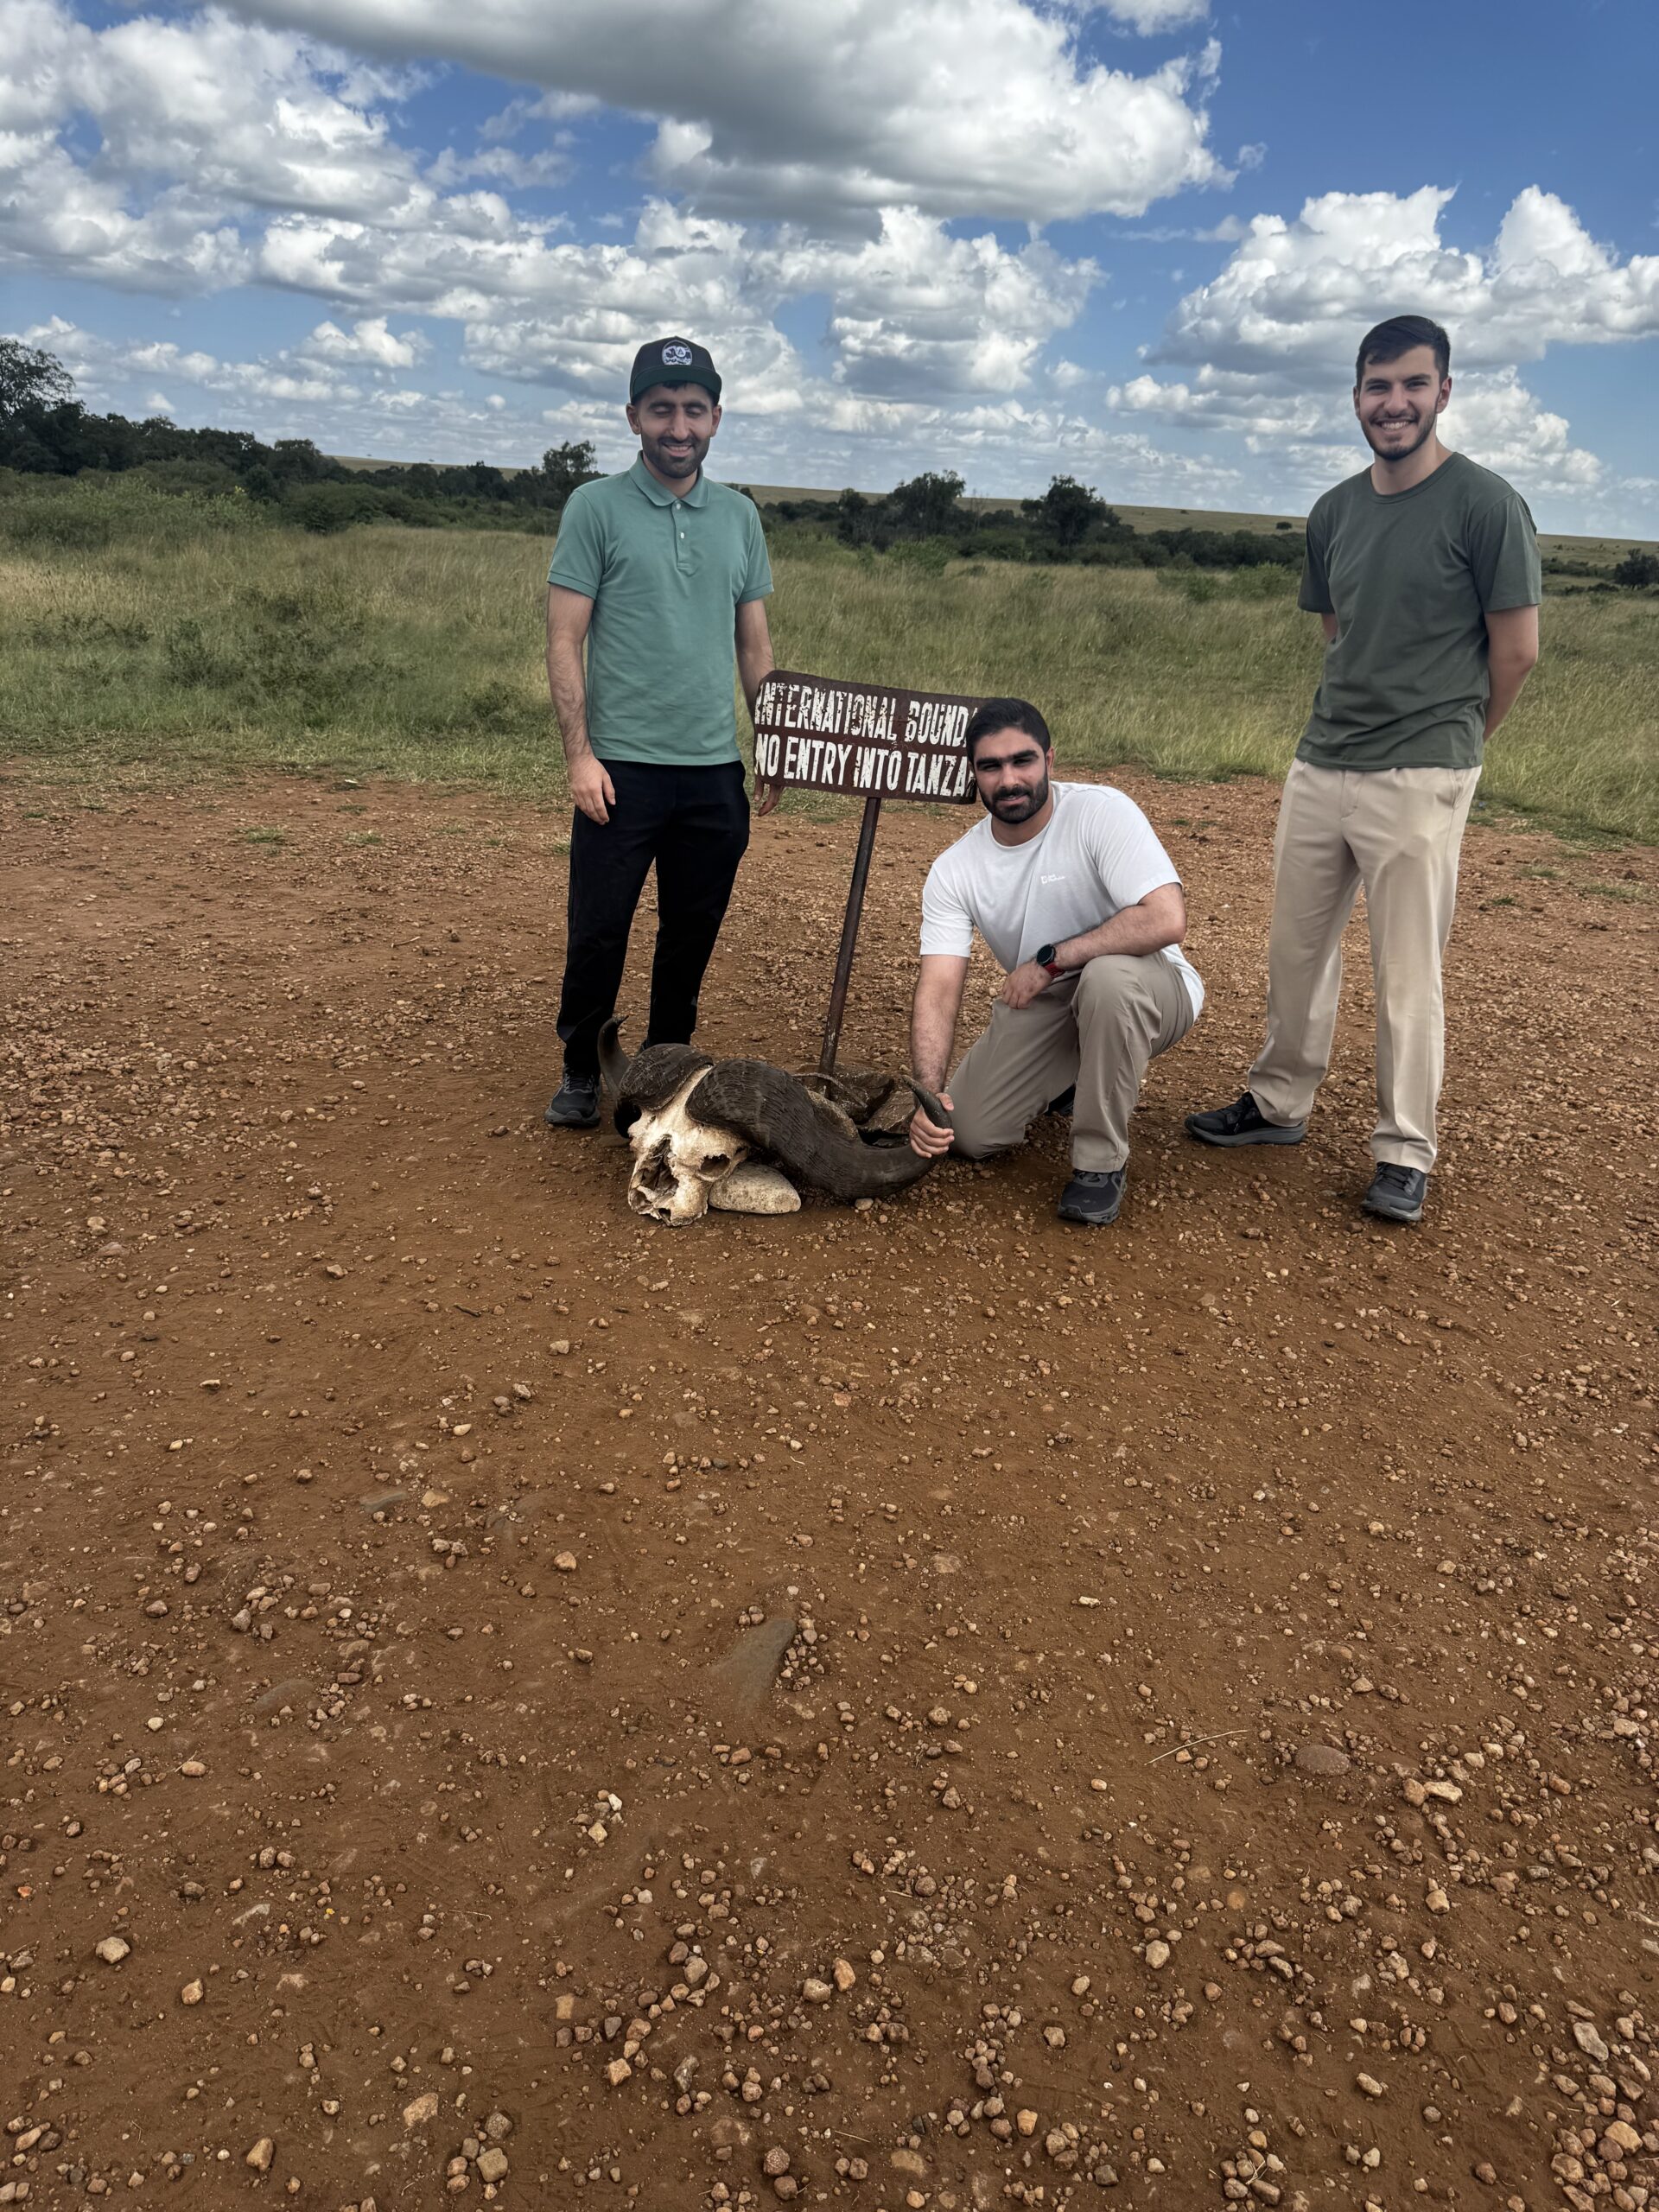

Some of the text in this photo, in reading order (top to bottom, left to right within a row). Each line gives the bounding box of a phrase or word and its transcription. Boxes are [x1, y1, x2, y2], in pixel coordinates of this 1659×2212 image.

[754, 682, 978, 747] INTERNATIONAL BOUND
[754, 733, 780, 777] NO
[784, 736, 853, 786] ENTRY
[853, 746, 902, 791] INTO
